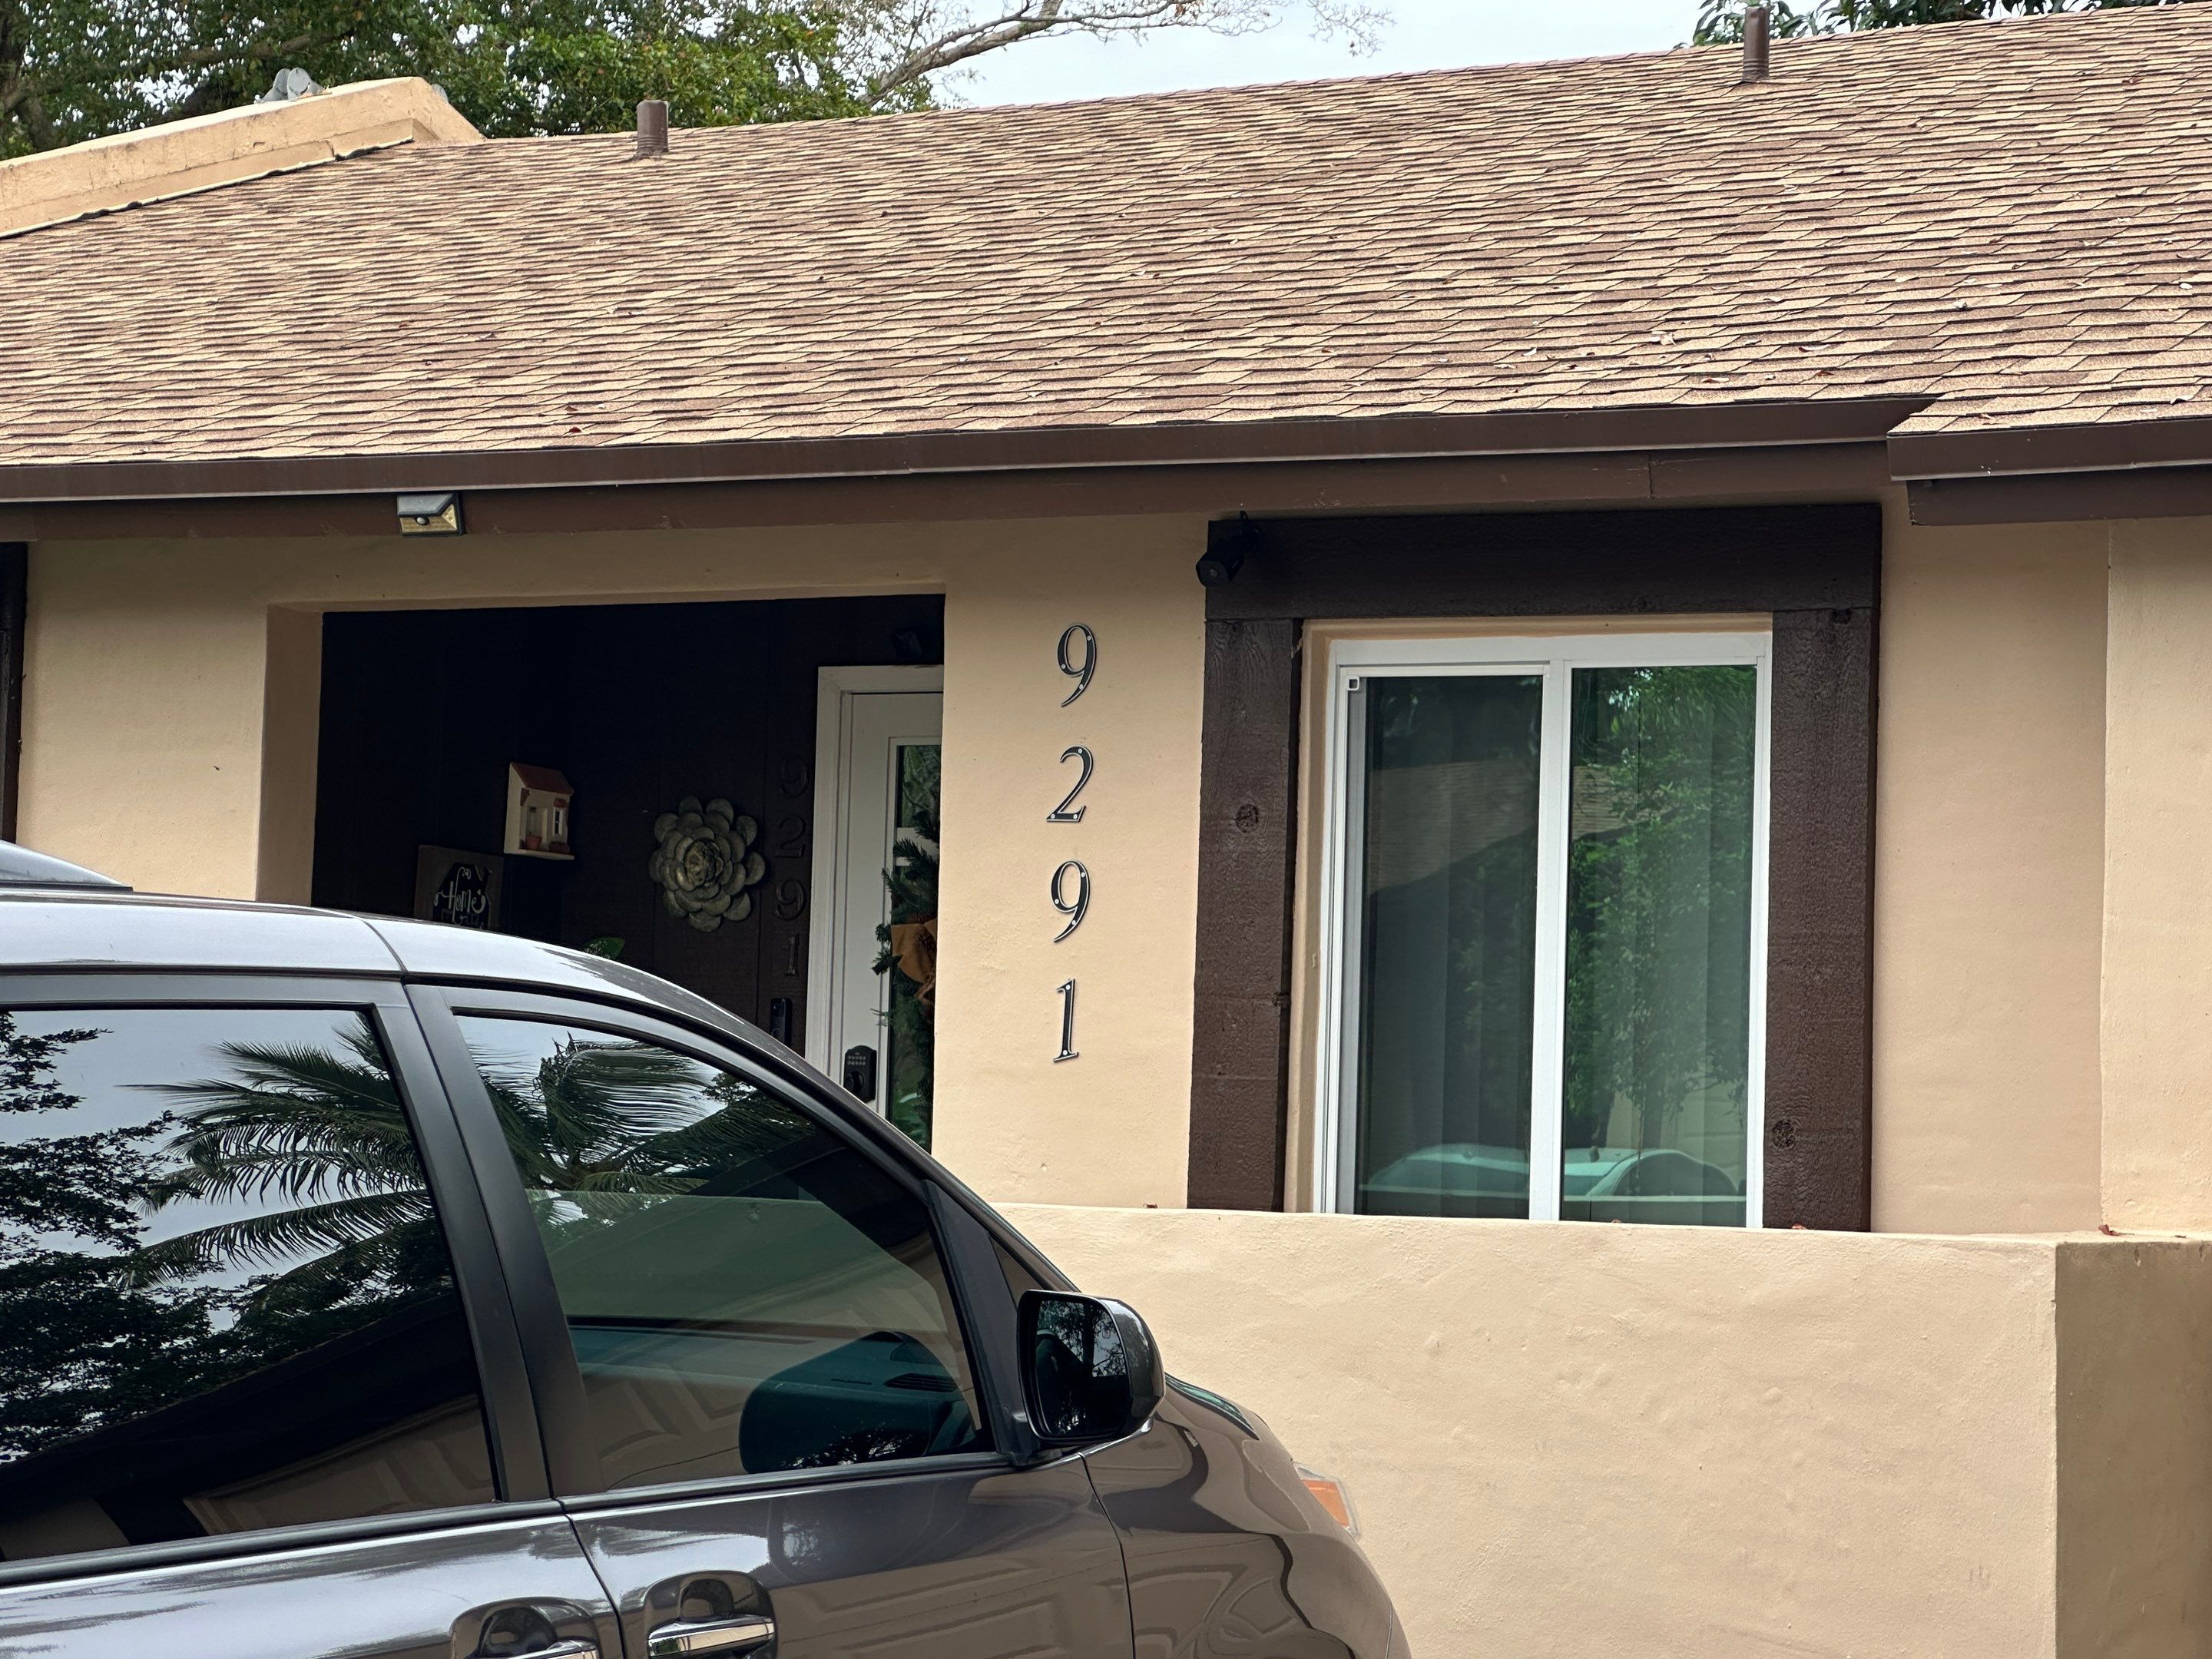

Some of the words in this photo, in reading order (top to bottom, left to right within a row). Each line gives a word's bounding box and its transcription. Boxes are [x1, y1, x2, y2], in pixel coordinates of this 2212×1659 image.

[434, 866, 486, 923] Home
[774, 754, 810, 976] 9291
[1046, 623, 1097, 1063] 9291
